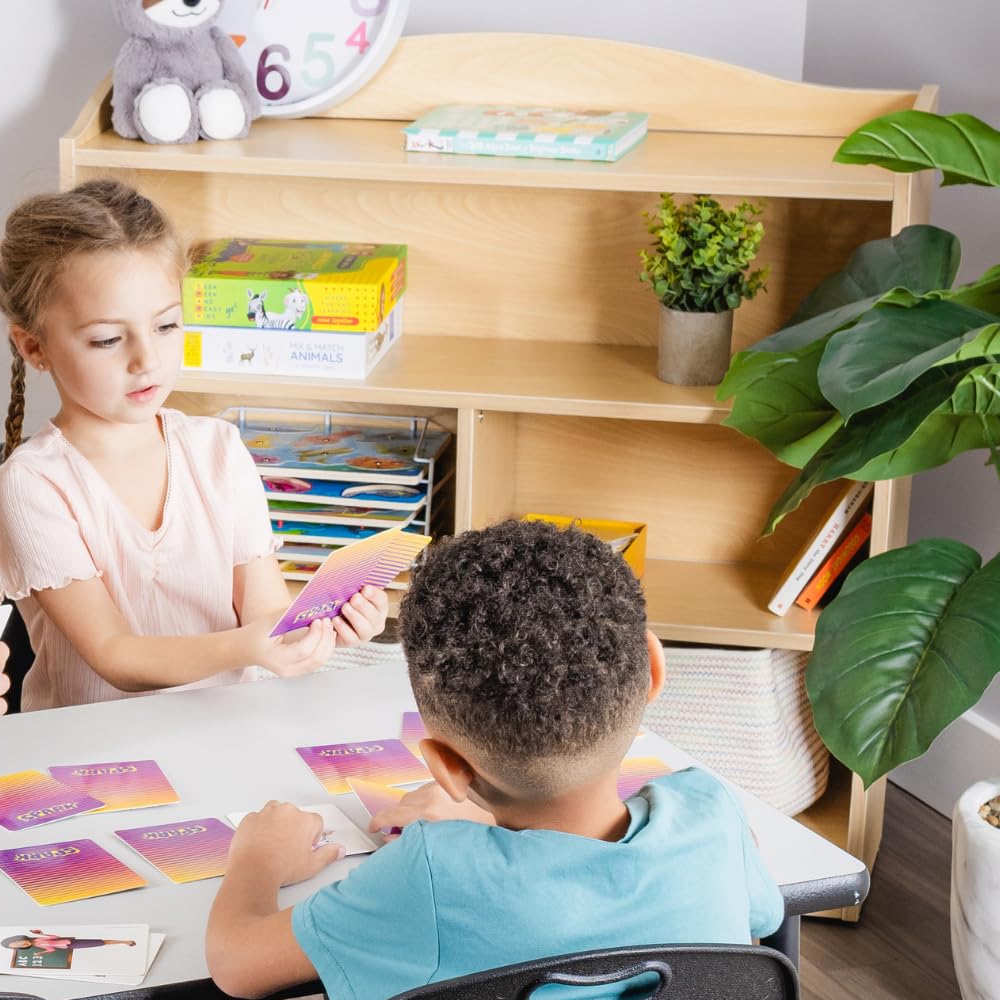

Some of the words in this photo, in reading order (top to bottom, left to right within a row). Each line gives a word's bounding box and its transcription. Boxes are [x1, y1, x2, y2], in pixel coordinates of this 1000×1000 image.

[301, 31, 336, 87] 5
[345, 20, 371, 55] 4
[256, 43, 292, 101] 6
[290, 351, 344, 363] ANIMALS
